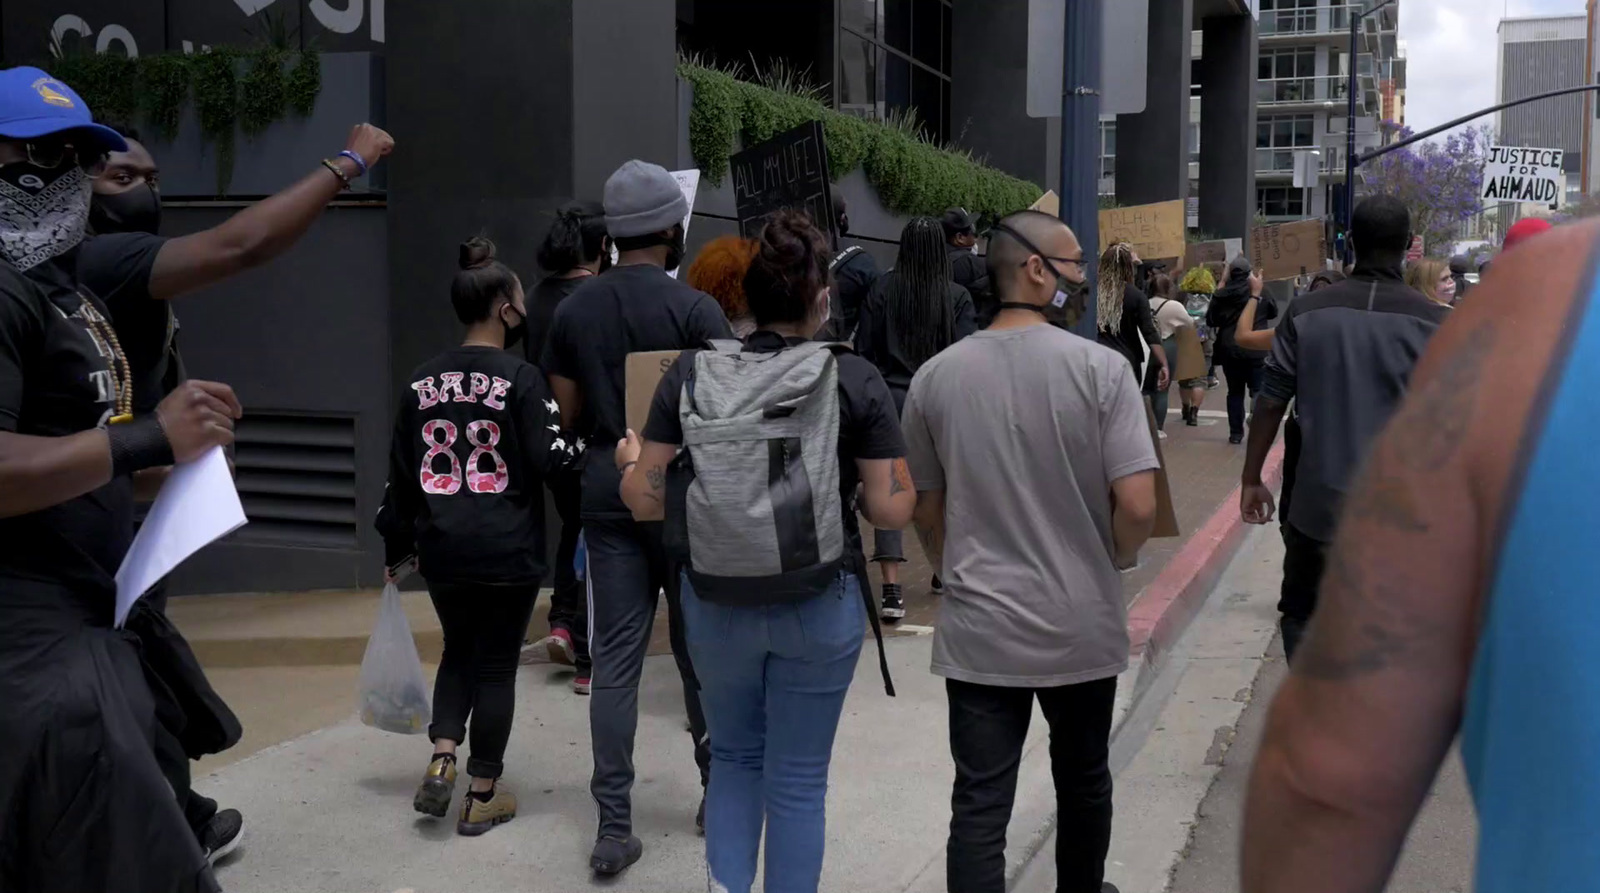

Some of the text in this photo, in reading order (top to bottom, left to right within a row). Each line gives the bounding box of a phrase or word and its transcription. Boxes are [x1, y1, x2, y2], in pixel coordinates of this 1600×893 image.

[736, 137, 815, 201] ALL MY LIFE
[1489, 148, 1561, 168] JUSTICE
[1509, 166, 1538, 175] FOR
[1484, 176, 1556, 201] AHMAUD
[410, 371, 513, 411] BAPE
[419, 418, 510, 496] 88
